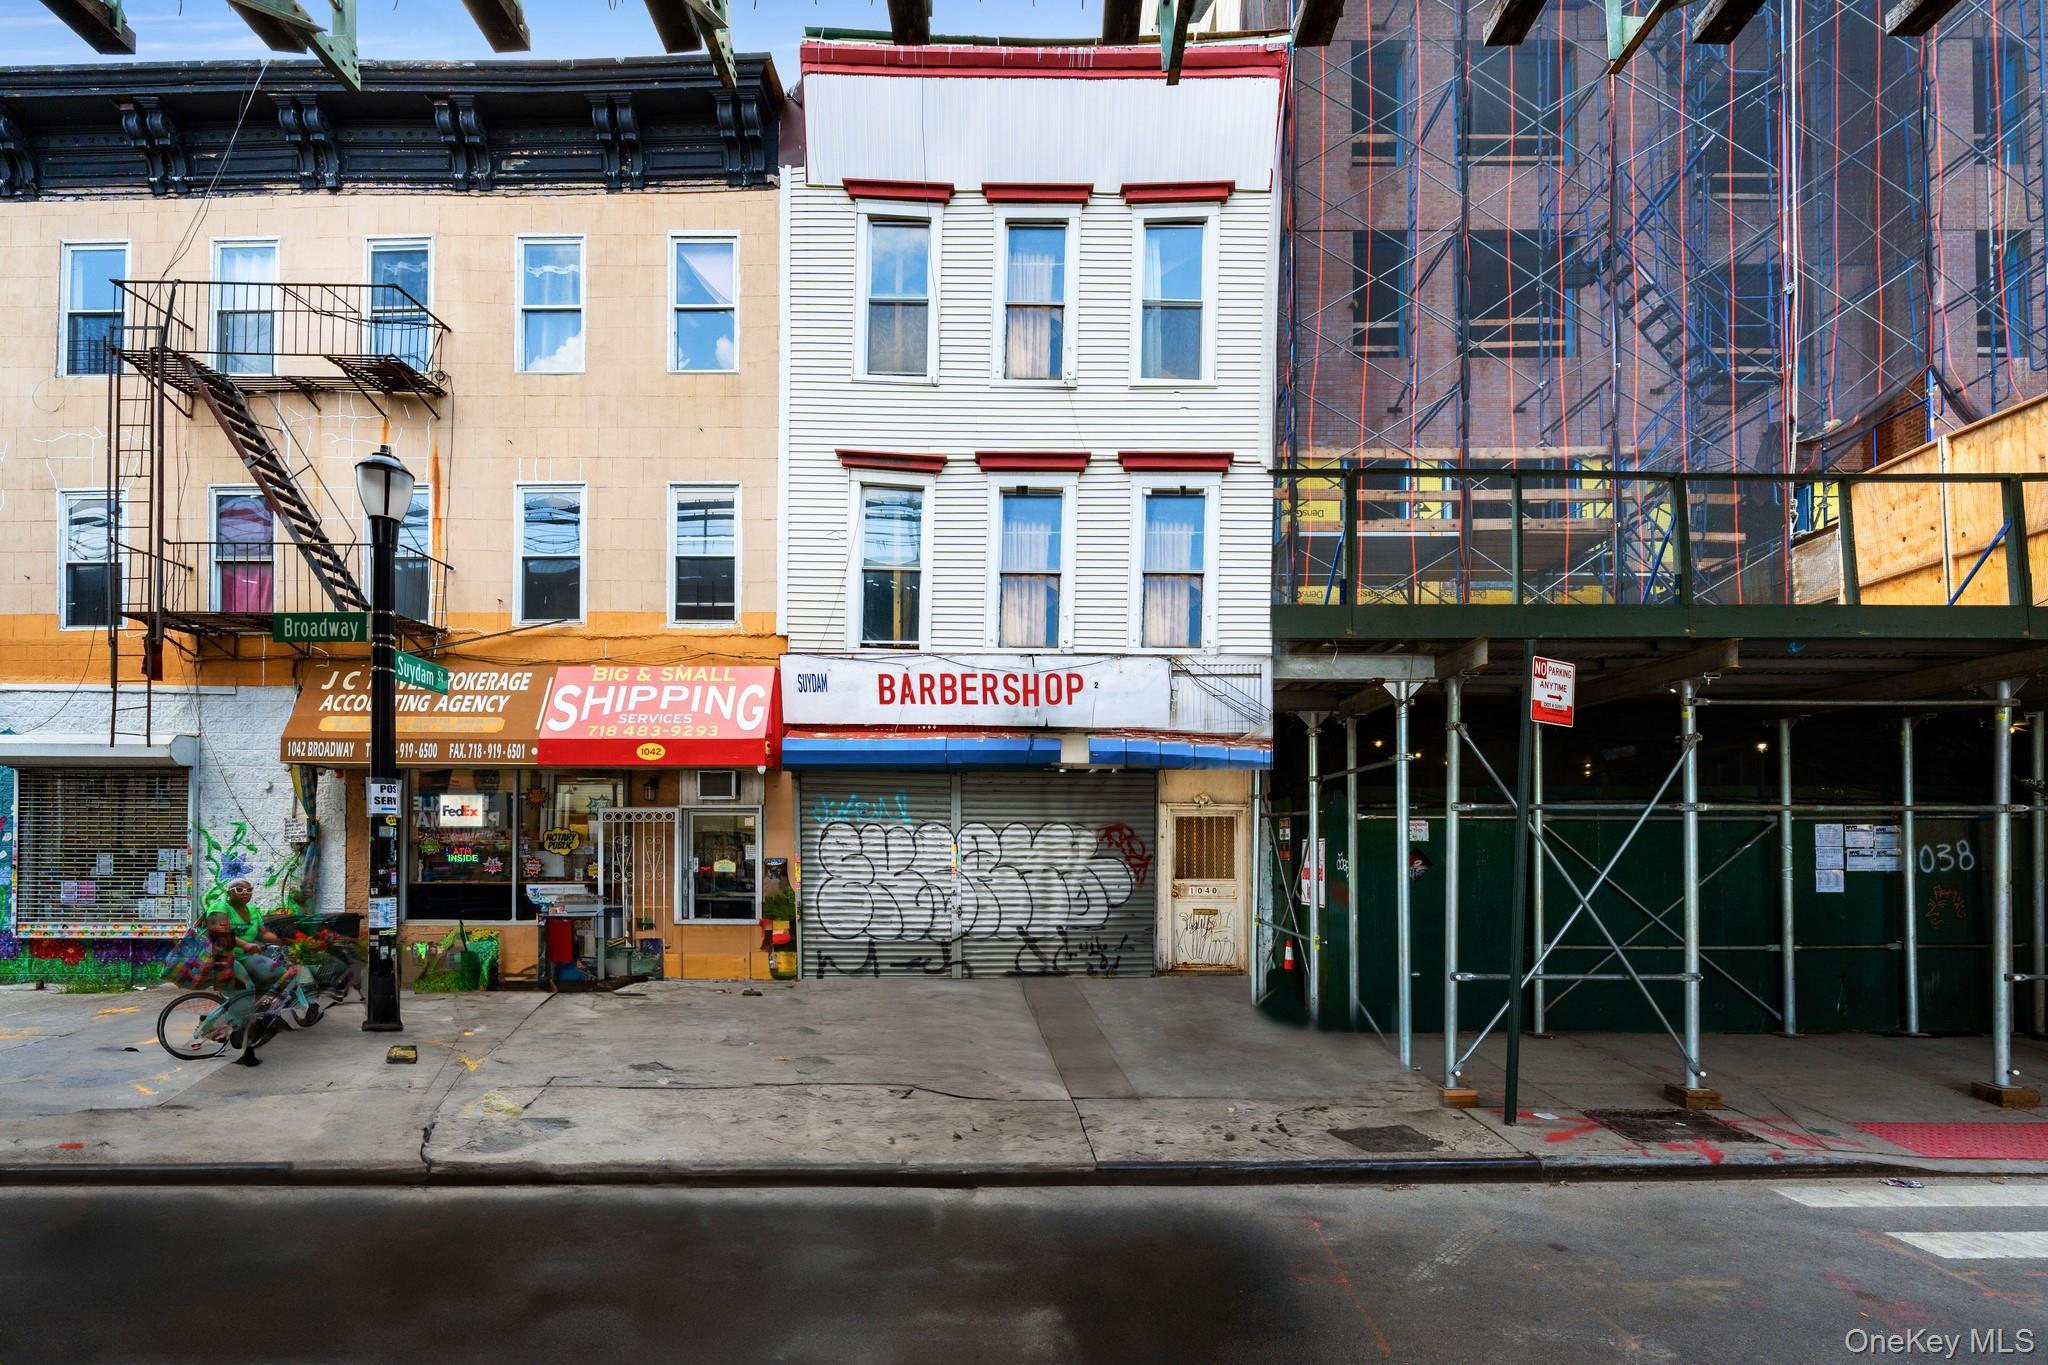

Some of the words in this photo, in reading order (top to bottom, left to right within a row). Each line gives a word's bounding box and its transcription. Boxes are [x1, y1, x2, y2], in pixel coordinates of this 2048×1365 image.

[284, 618, 358, 641] Broadway
[397, 655, 434, 687] Suydam
[592, 667, 629, 682] BIG
[636, 667, 651, 682] &
[660, 667, 737, 682] SMALL
[1535, 660, 1547, 676] NO
[1548, 666, 1571, 679] PARKING
[321, 671, 339, 690] J
[342, 671, 361, 690] C
[447, 672, 533, 691] ROKERAGE
[1540, 681, 1567, 693] ANYTIME
[797, 673, 828, 693] SUYDAM
[877, 672, 1084, 707] BARBERSHOP
[433, 694, 511, 712] AGENCY
[546, 684, 767, 732] SHIPPING
[617, 713, 693, 724] SERVICES
[588, 725, 617, 737] 718
[622, 724, 719, 737] 483-9293
[287, 741, 307, 757] 1042
[308, 741, 355, 757] BROADWAY
[640, 747, 662, 756] 1042
[442, 805, 478, 816] FedEx
[546, 833, 577, 842] NOTARY
[453, 847, 472, 855] ATM
[548, 841, 574, 849] PUBLIC
[448, 854, 479, 862] INSIDE
